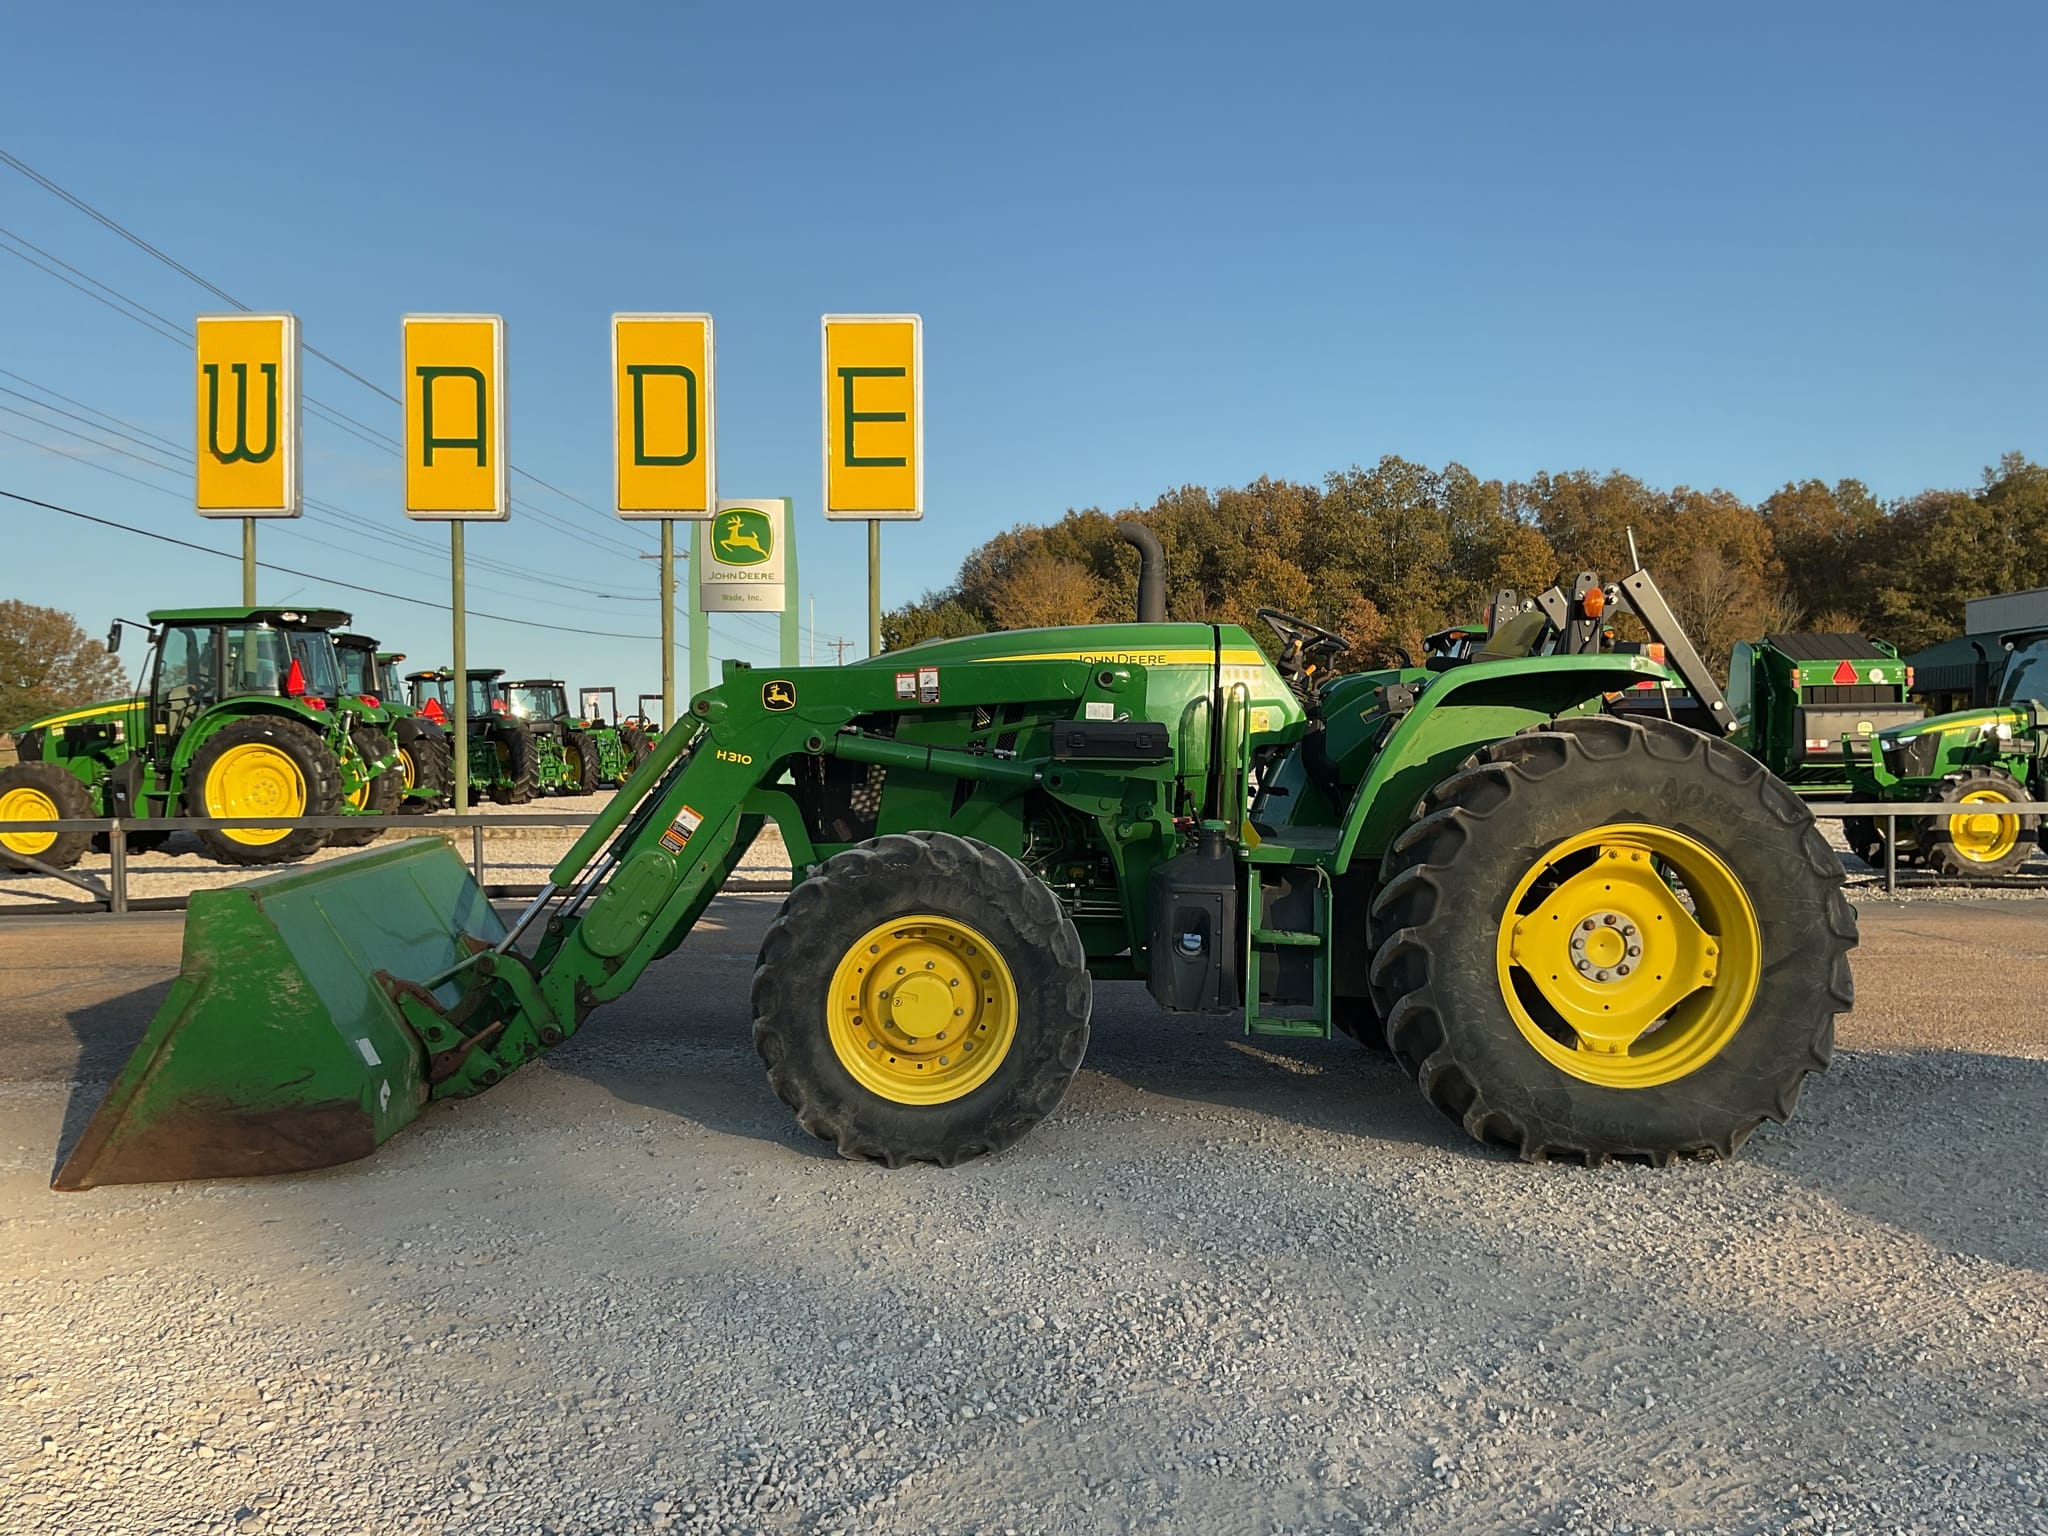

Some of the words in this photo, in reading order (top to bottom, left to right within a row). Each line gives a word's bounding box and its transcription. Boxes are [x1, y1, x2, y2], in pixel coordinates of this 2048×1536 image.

[708, 571, 738, 579] JOHN
[739, 571, 775, 579] DEERE
[1117, 653, 1167, 664] DEERE
